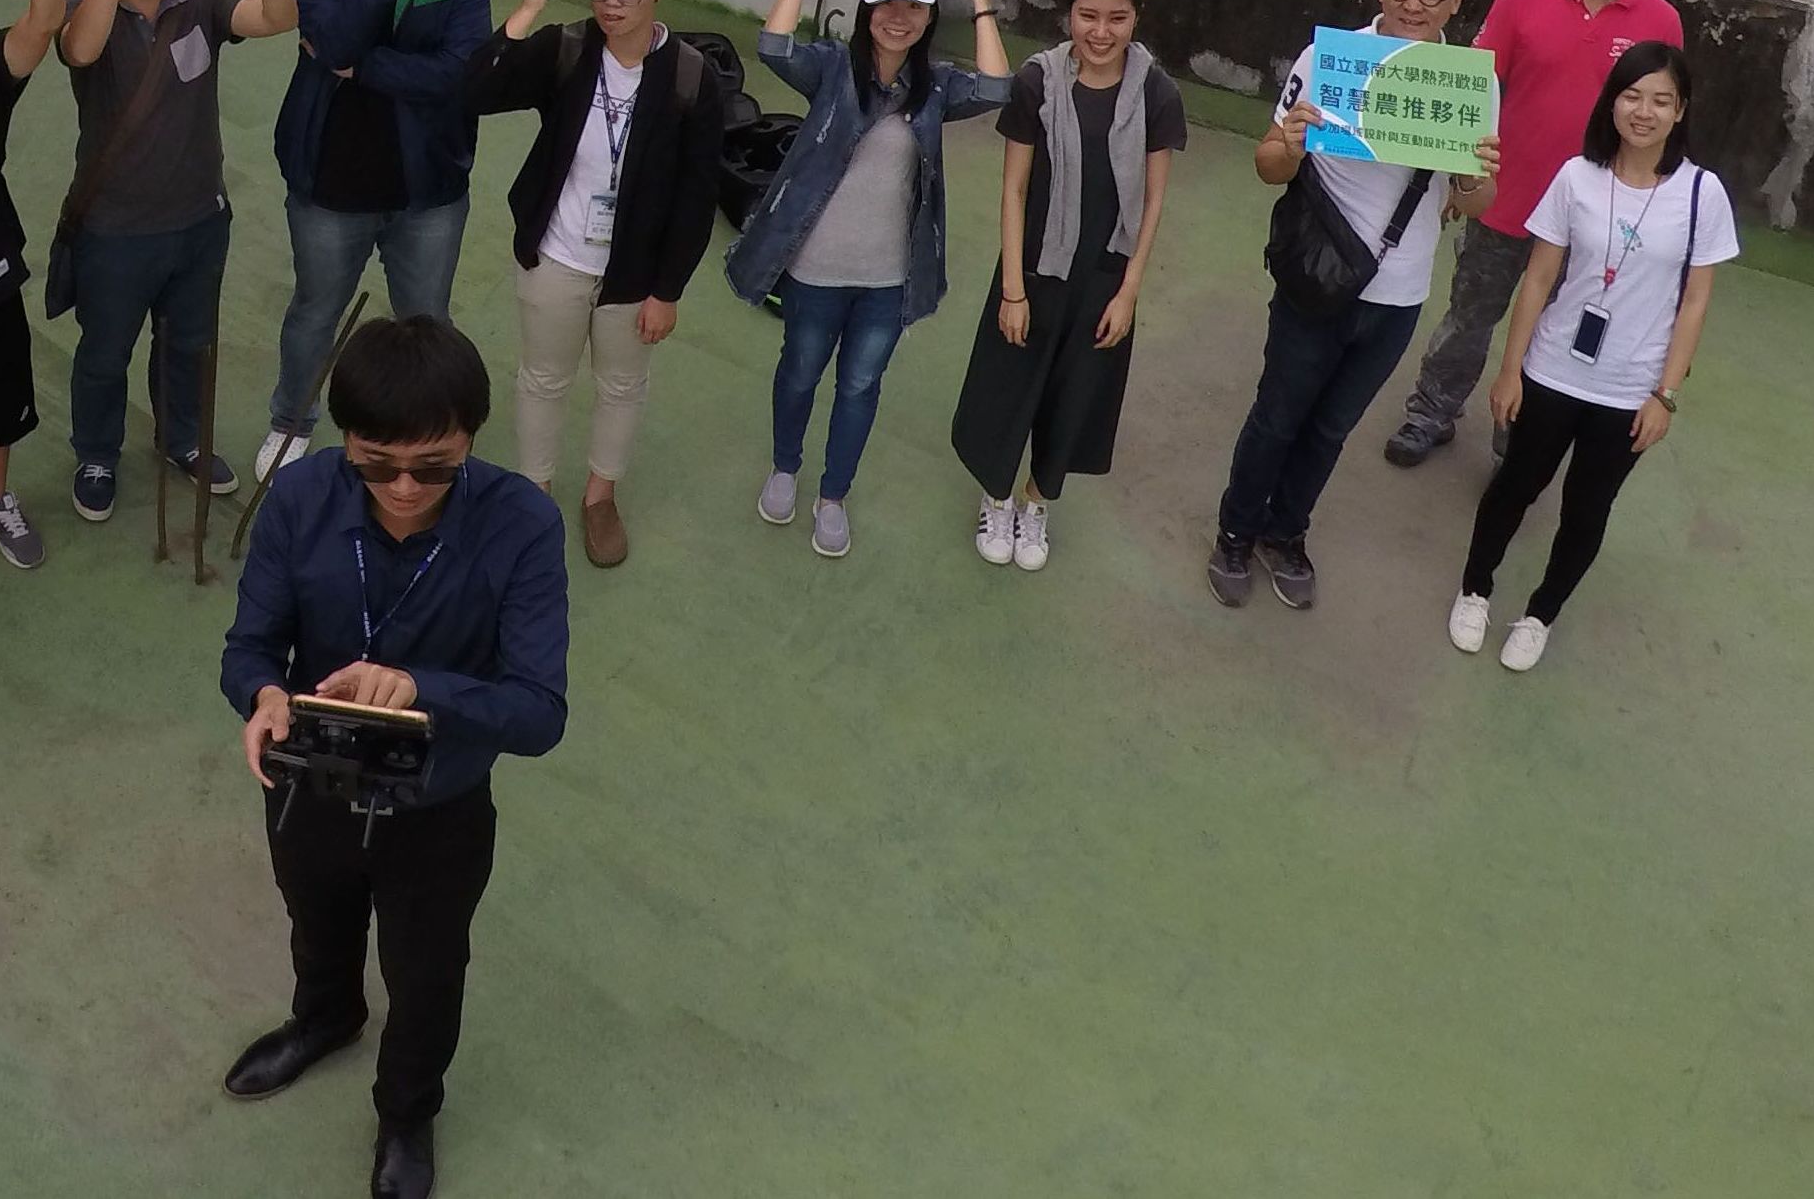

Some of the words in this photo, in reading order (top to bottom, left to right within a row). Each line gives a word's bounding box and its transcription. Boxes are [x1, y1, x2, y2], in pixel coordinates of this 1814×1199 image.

[1319, 53, 1487, 93] 國立臺南大學熱烈歡迎
[1319, 82, 1481, 128] 智慧農推夥伴
